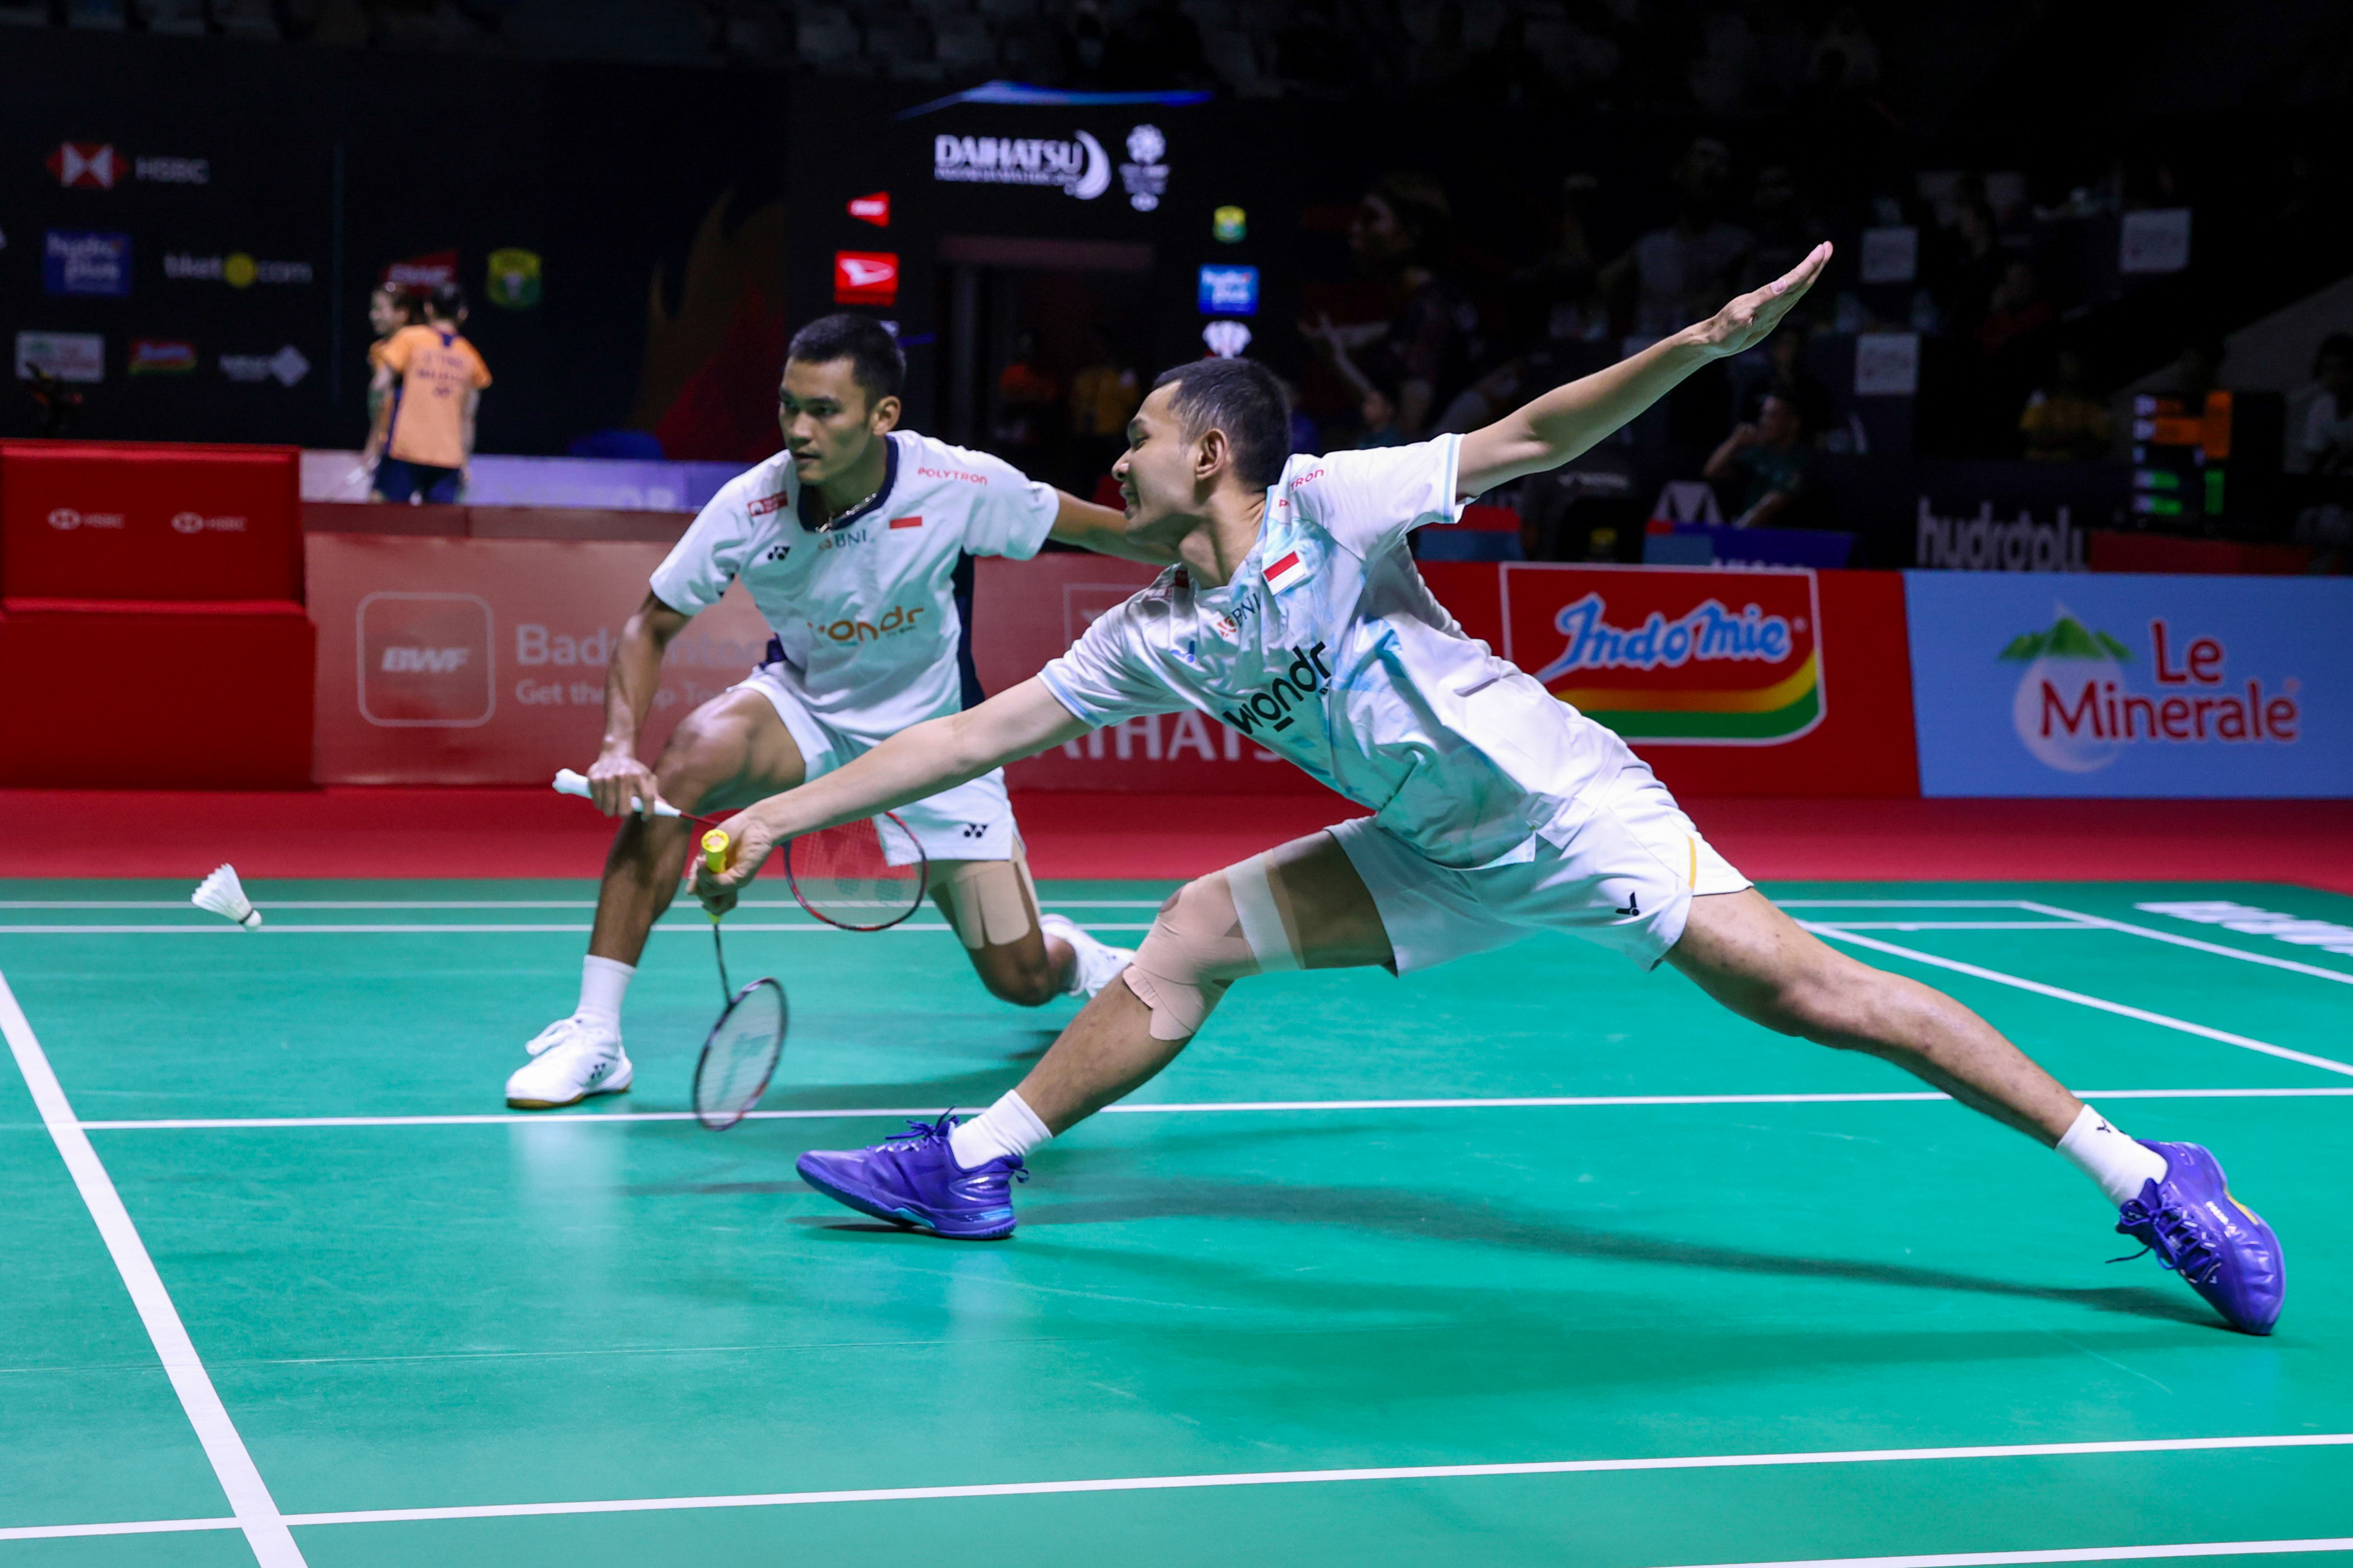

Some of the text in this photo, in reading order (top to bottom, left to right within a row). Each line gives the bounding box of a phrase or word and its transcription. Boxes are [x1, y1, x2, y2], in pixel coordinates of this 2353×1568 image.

[935, 134, 1084, 174] DAIHATSU
[834, 529, 867, 548] BNI
[807, 605, 925, 642] ondr
[380, 646, 471, 673] BWF
[2150, 619, 2225, 684] Le
[515, 680, 565, 707] Get
[1224, 641, 1331, 734] wondr
[2039, 679, 2299, 741] Minerale
